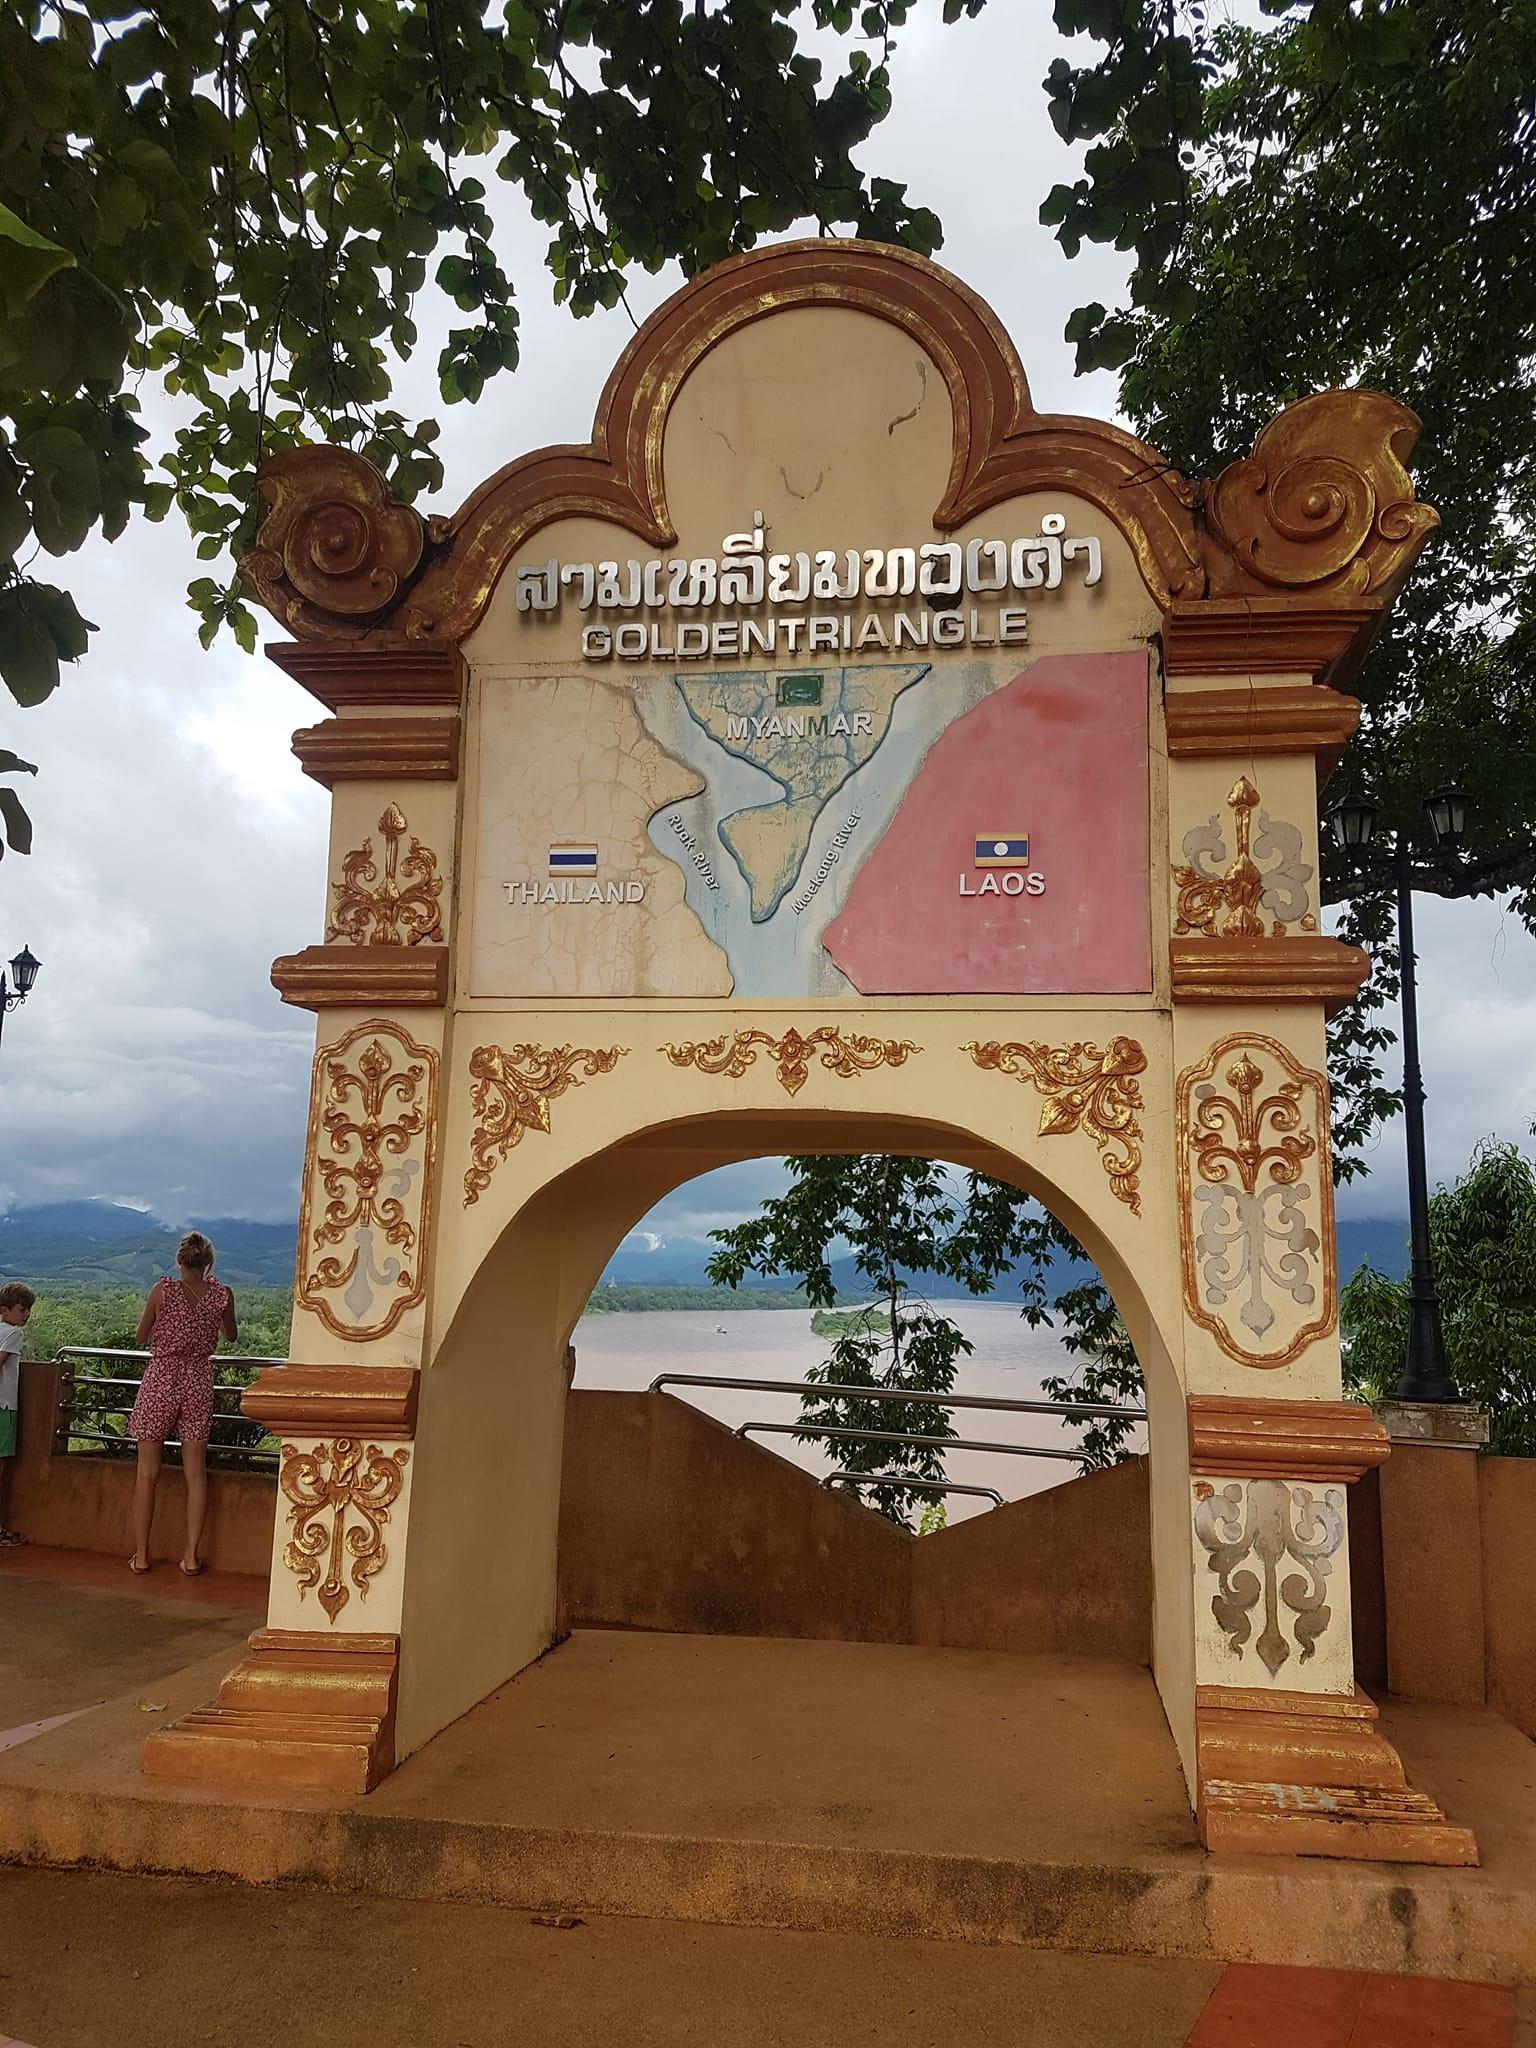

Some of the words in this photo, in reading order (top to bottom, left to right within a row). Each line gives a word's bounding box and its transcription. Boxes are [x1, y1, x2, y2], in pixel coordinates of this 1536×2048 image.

[582, 607, 1029, 658] GOLDENTRIANGLE
[727, 712, 873, 740] MYANMAR
[692, 851, 720, 892] River
[790, 849, 839, 916] Maekong
[832, 810, 862, 849] River
[503, 880, 646, 905] THAILAND
[959, 872, 1046, 896] LAOS
